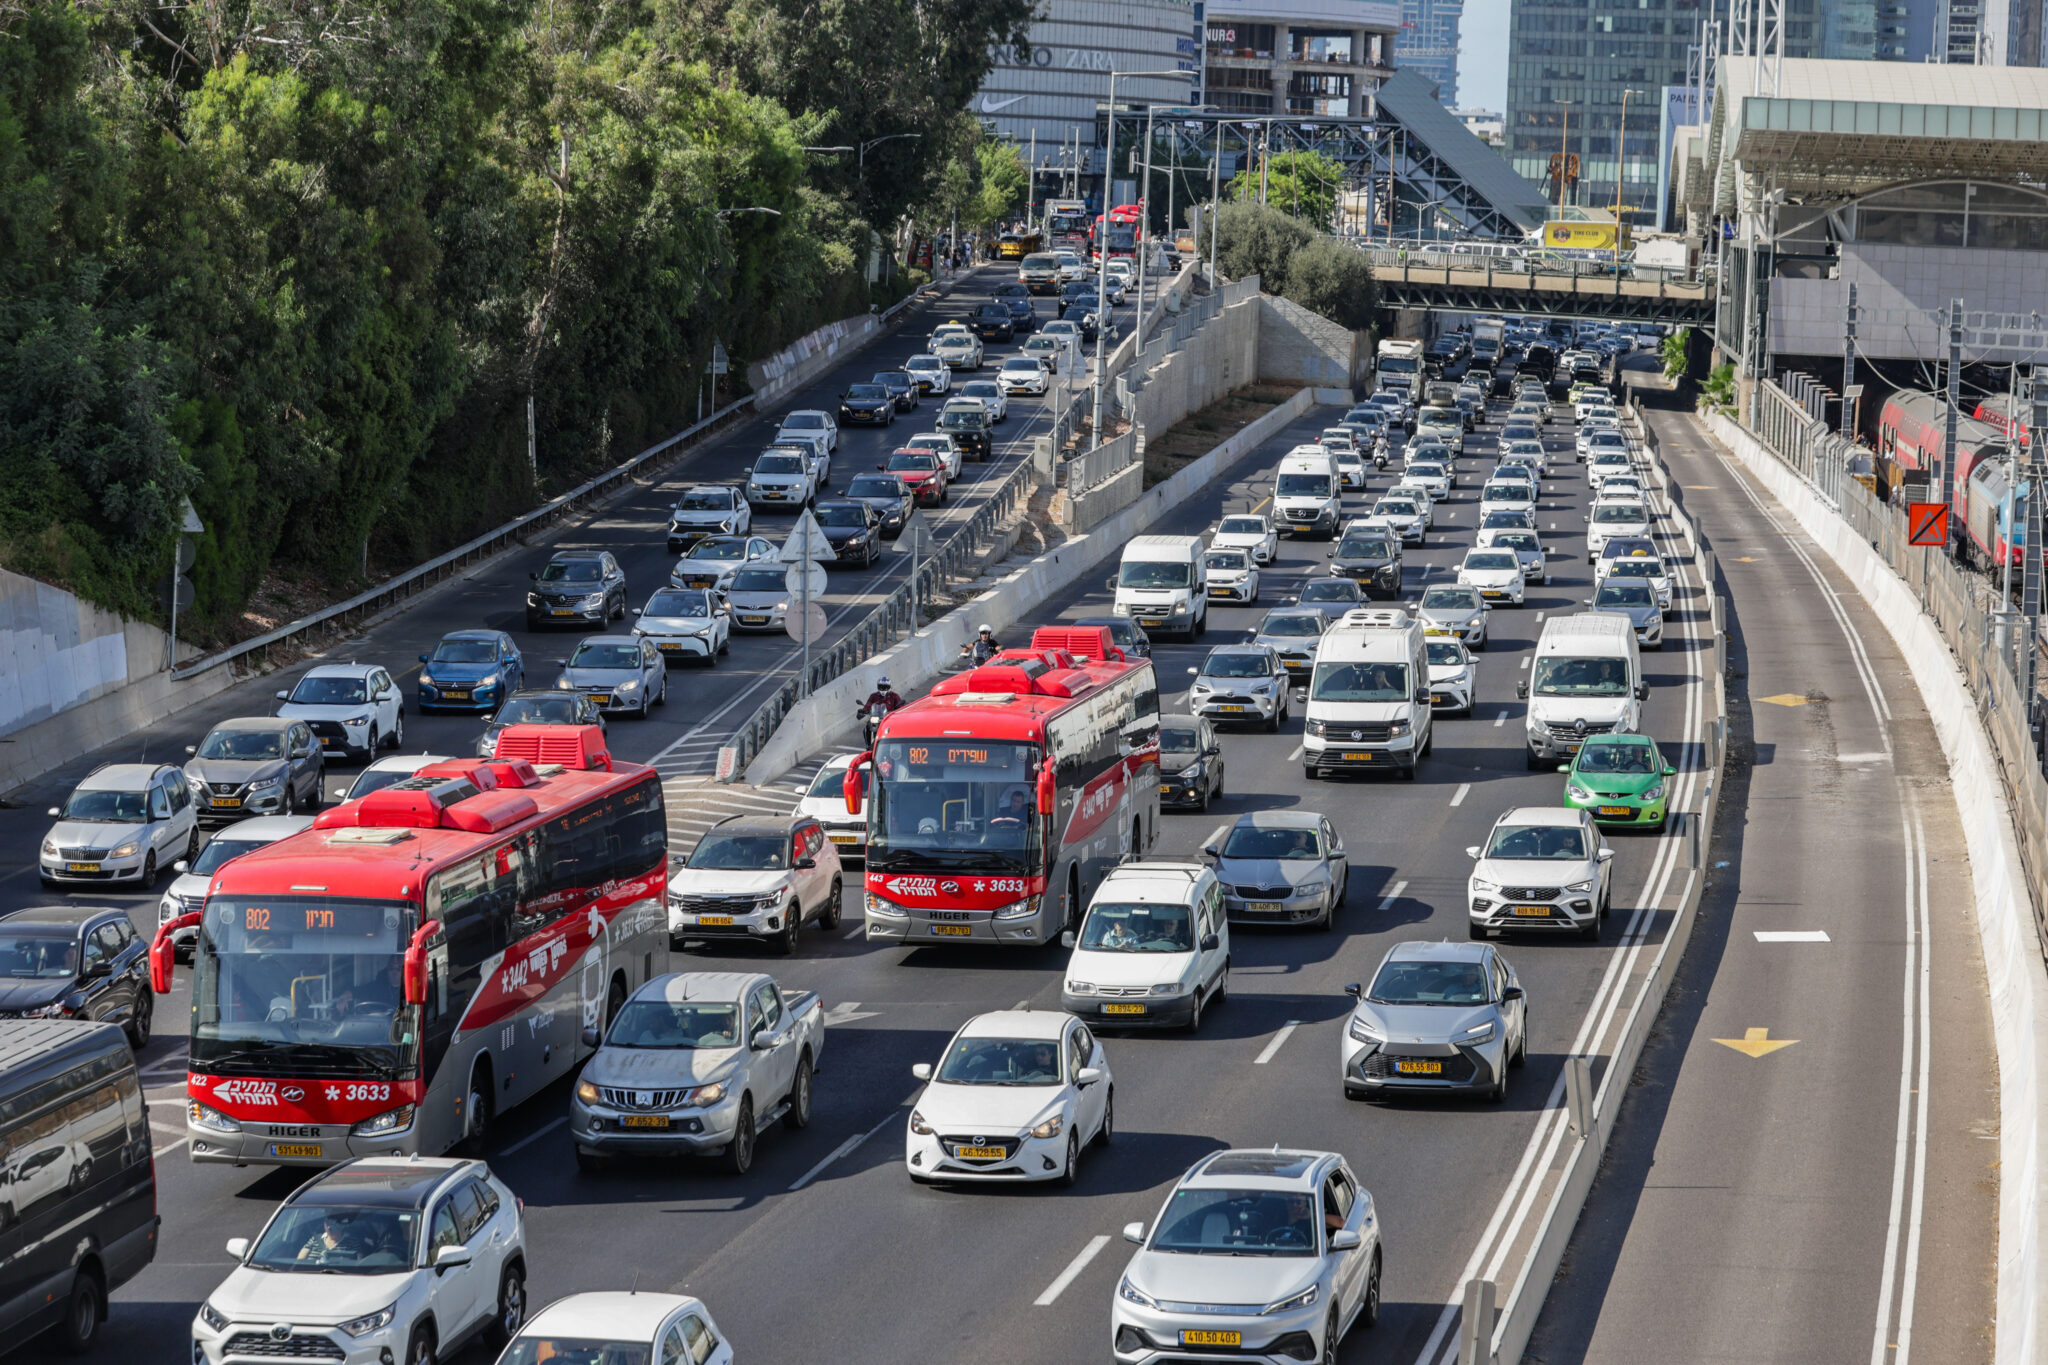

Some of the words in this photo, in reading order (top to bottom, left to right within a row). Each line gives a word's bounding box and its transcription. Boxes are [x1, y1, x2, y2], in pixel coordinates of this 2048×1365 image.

[1065, 49, 1115, 71] ZARA
[909, 747, 929, 764] 802
[869, 874, 883, 883] 443
[900, 877, 937, 888] הנתיב
[900, 886, 938, 897] המהיר
[246, 908, 270, 930] 802
[306, 909, 334, 930] חניון
[929, 911, 970, 920] HIGER
[190, 1074, 207, 1086] 422
[230, 1080, 277, 1093] הנתיב
[230, 1092, 278, 1106] המהיר
[268, 1126, 320, 1137] HIGER
